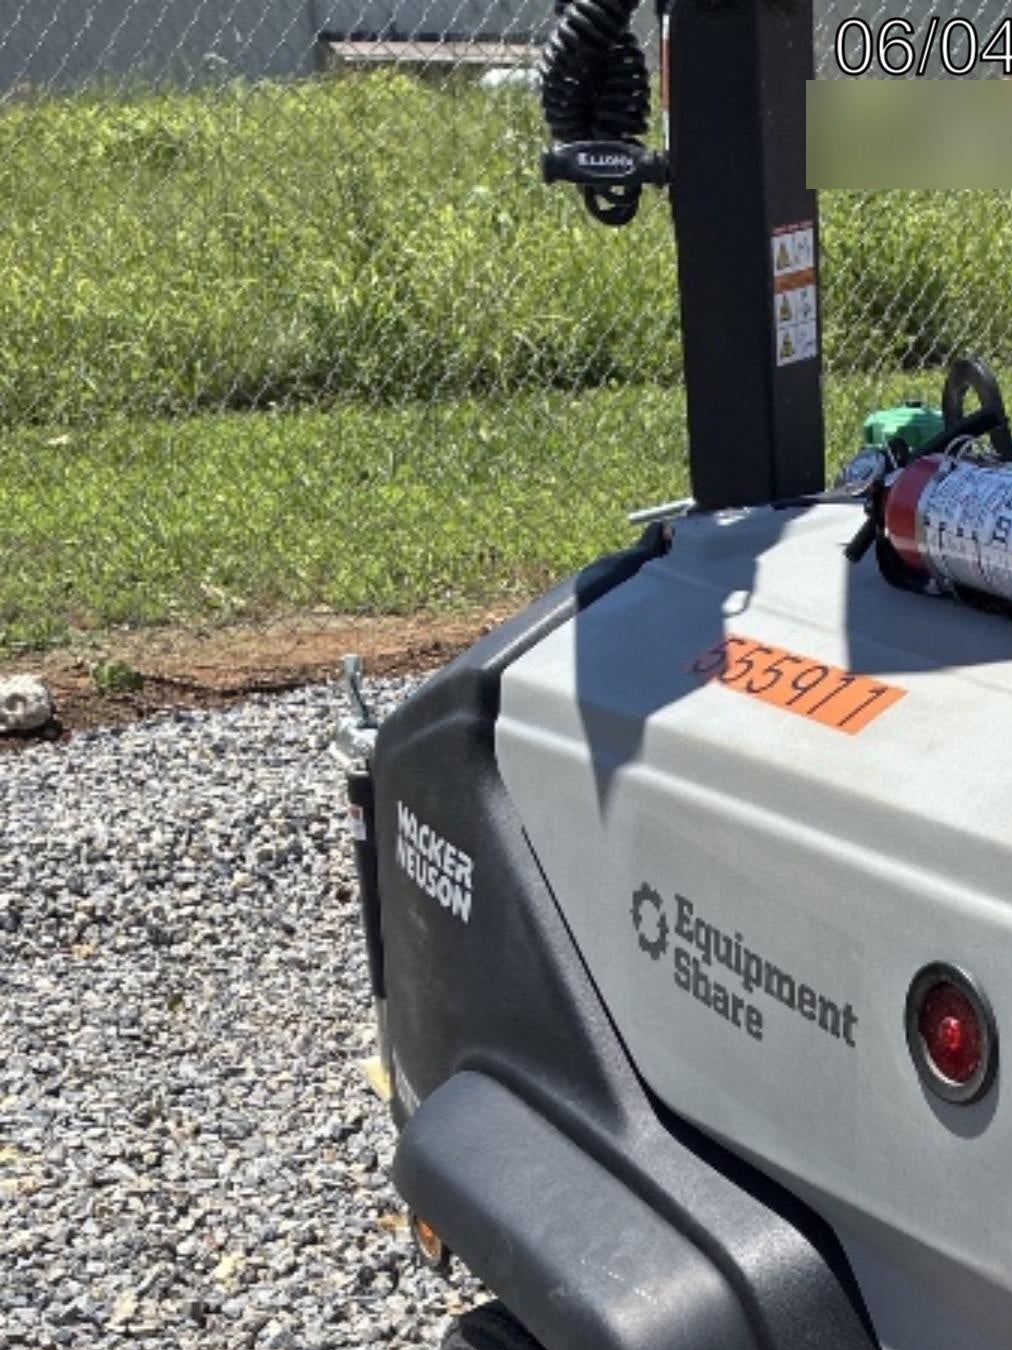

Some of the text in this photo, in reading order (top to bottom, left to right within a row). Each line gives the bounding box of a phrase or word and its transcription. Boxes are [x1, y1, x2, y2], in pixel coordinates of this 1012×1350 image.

[692, 638, 889, 727] 555911
[396, 833, 473, 924] NEUSON
[397, 800, 473, 889] WACKER
[674, 893, 858, 1048] Equipment
[674, 947, 763, 1041] Share
